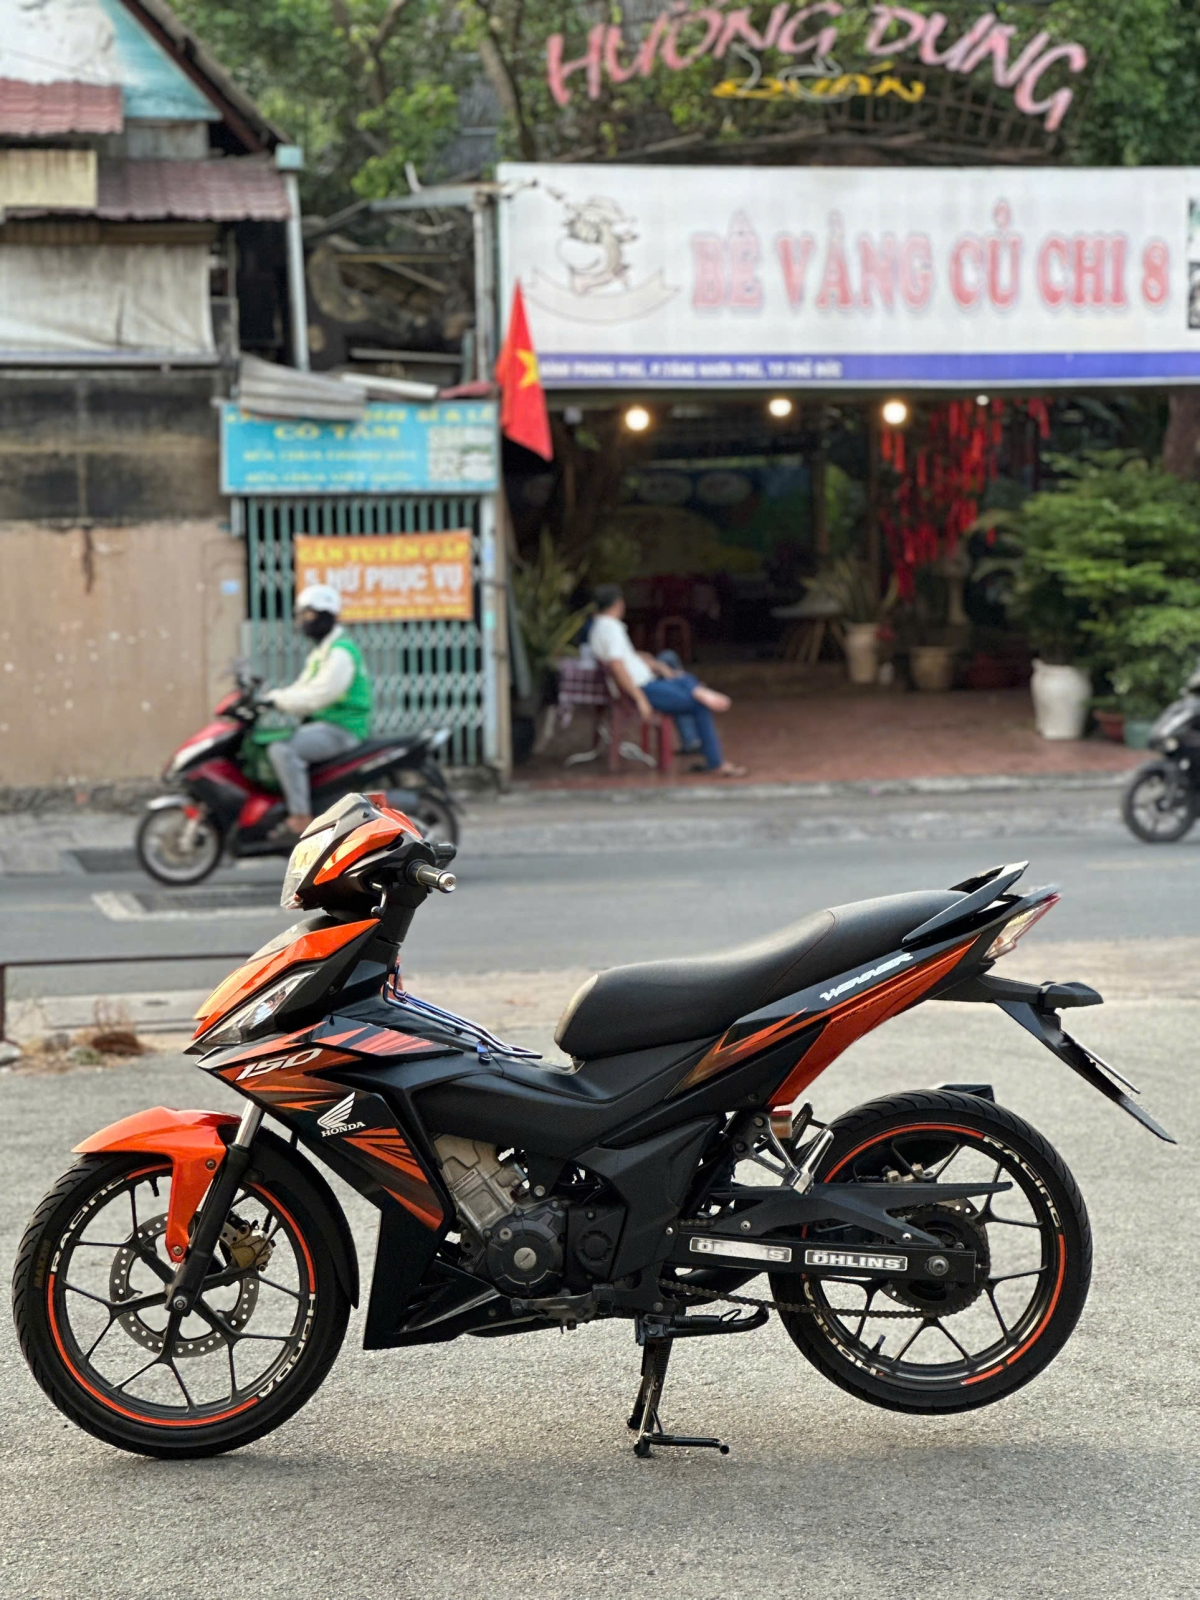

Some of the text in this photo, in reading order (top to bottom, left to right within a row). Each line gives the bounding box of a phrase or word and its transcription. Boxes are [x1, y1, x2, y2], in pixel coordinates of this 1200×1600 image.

[948, 199, 1023, 311] CỦ
[1037, 234, 1128, 310] CHI
[1142, 241, 1170, 308] 8
[235, 1048, 324, 1081] 150
[321, 1121, 366, 1138] HONDA
[812, 1251, 901, 1269] ÖHLINS
[258, 1293, 317, 1398] HONDA
